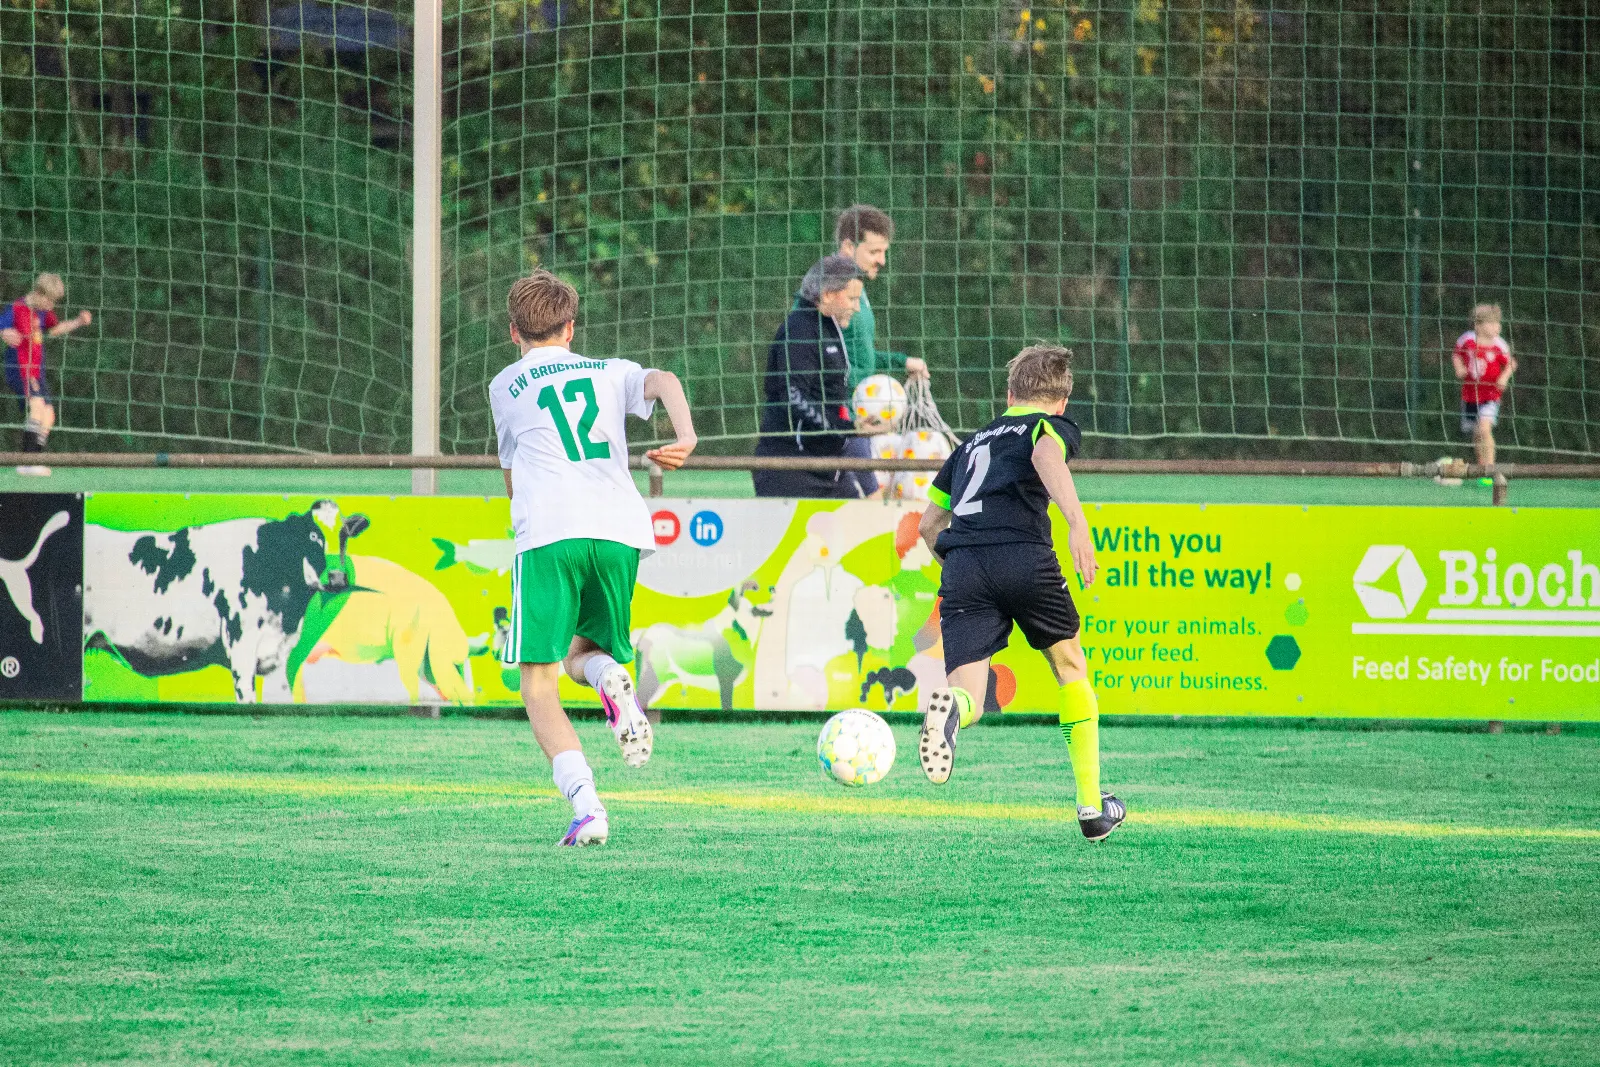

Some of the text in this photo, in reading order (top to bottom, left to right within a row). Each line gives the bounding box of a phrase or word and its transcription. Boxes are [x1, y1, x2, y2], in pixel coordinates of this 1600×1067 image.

[508, 373, 528, 399] GW
[536, 377, 611, 462] 12
[953, 442, 991, 517] 2
[1092, 526, 1222, 559] With you
[1106, 560, 1272, 595] all the way!
[1084, 615, 1262, 638] For your animals.
[1101, 646, 1145, 664] your
[1151, 642, 1199, 662] feed.
[1093, 671, 1268, 692] For your business.
[1352, 656, 1600, 686] Feed Safety for Food
